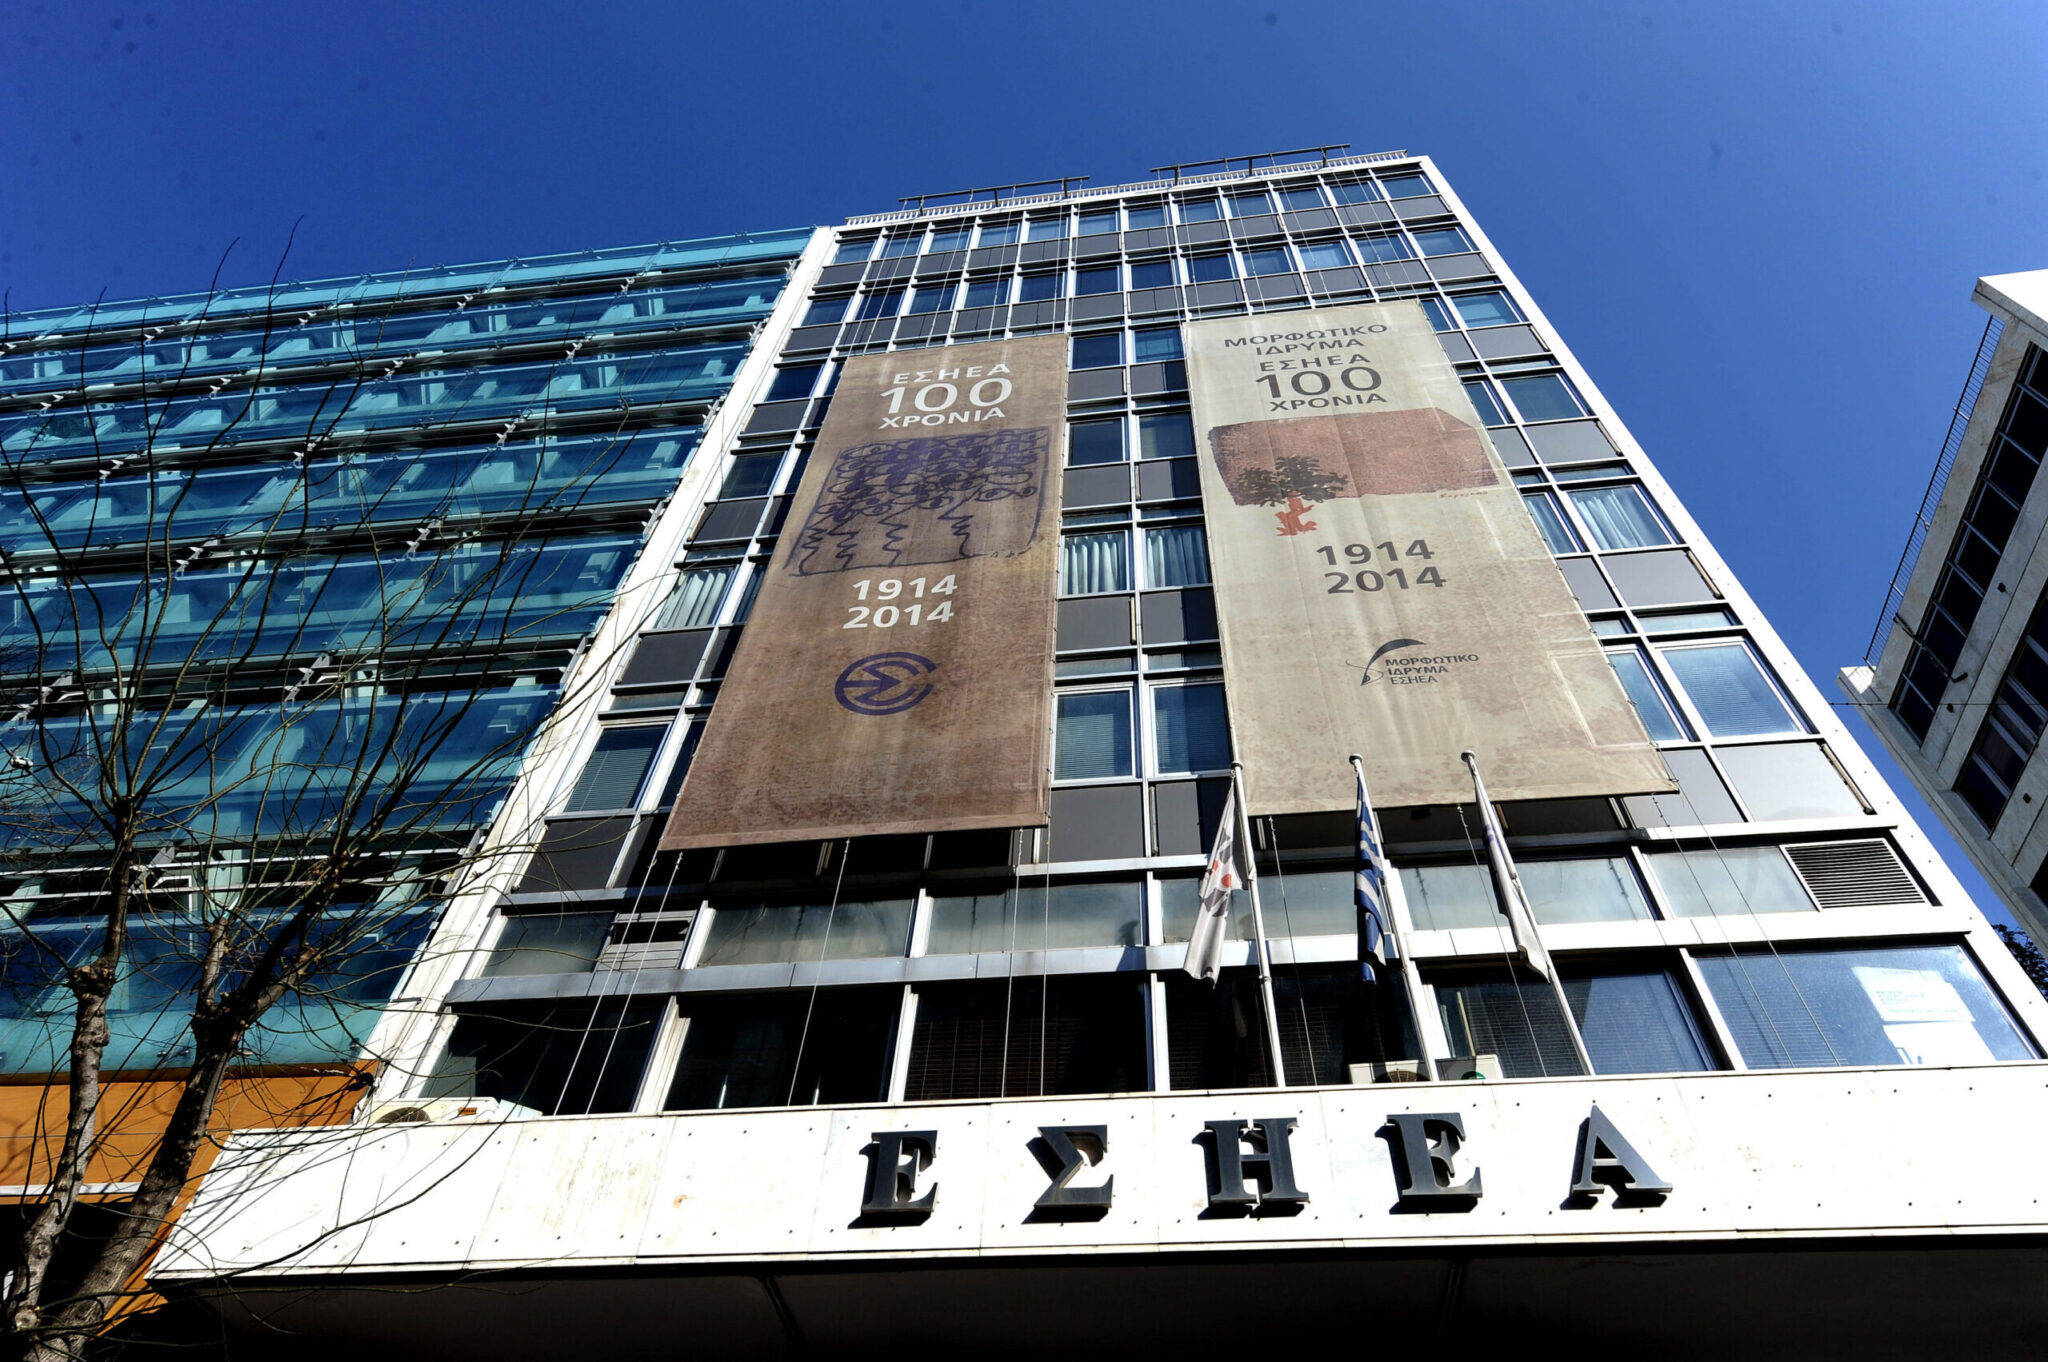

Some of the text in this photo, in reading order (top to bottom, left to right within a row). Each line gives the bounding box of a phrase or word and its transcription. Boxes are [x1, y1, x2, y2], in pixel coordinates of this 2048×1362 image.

[1224, 324, 1388, 347] ΜΟΡΦΩΤΙΚΟ
[1256, 338, 1364, 356] ΙΔΡΥΜΑ
[893, 363, 1011, 385] ΕΣΗΕΑ
[1260, 353, 1371, 372] ΕΣΗΕΑ
[1255, 366, 1382, 398] 100
[880, 377, 1013, 414] 100
[1270, 393, 1388, 412] ΧΡΟΝΙΑ
[878, 407, 1006, 430] ΧΡΟΝΙΑ
[1316, 539, 1435, 566] 1914
[852, 574, 958, 601] 1914
[1324, 566, 1447, 594] 2014
[842, 600, 955, 629] 2014
[1385, 654, 1479, 667] ΜΟΡΦΩΤΙΚΟ
[1388, 666, 1448, 676] ΙΔΡΥΜΑ
[1390, 676, 1438, 685] ΕΣΗΕΑ
[848, 1104, 1673, 1229] ΕΣΗΕΑ
